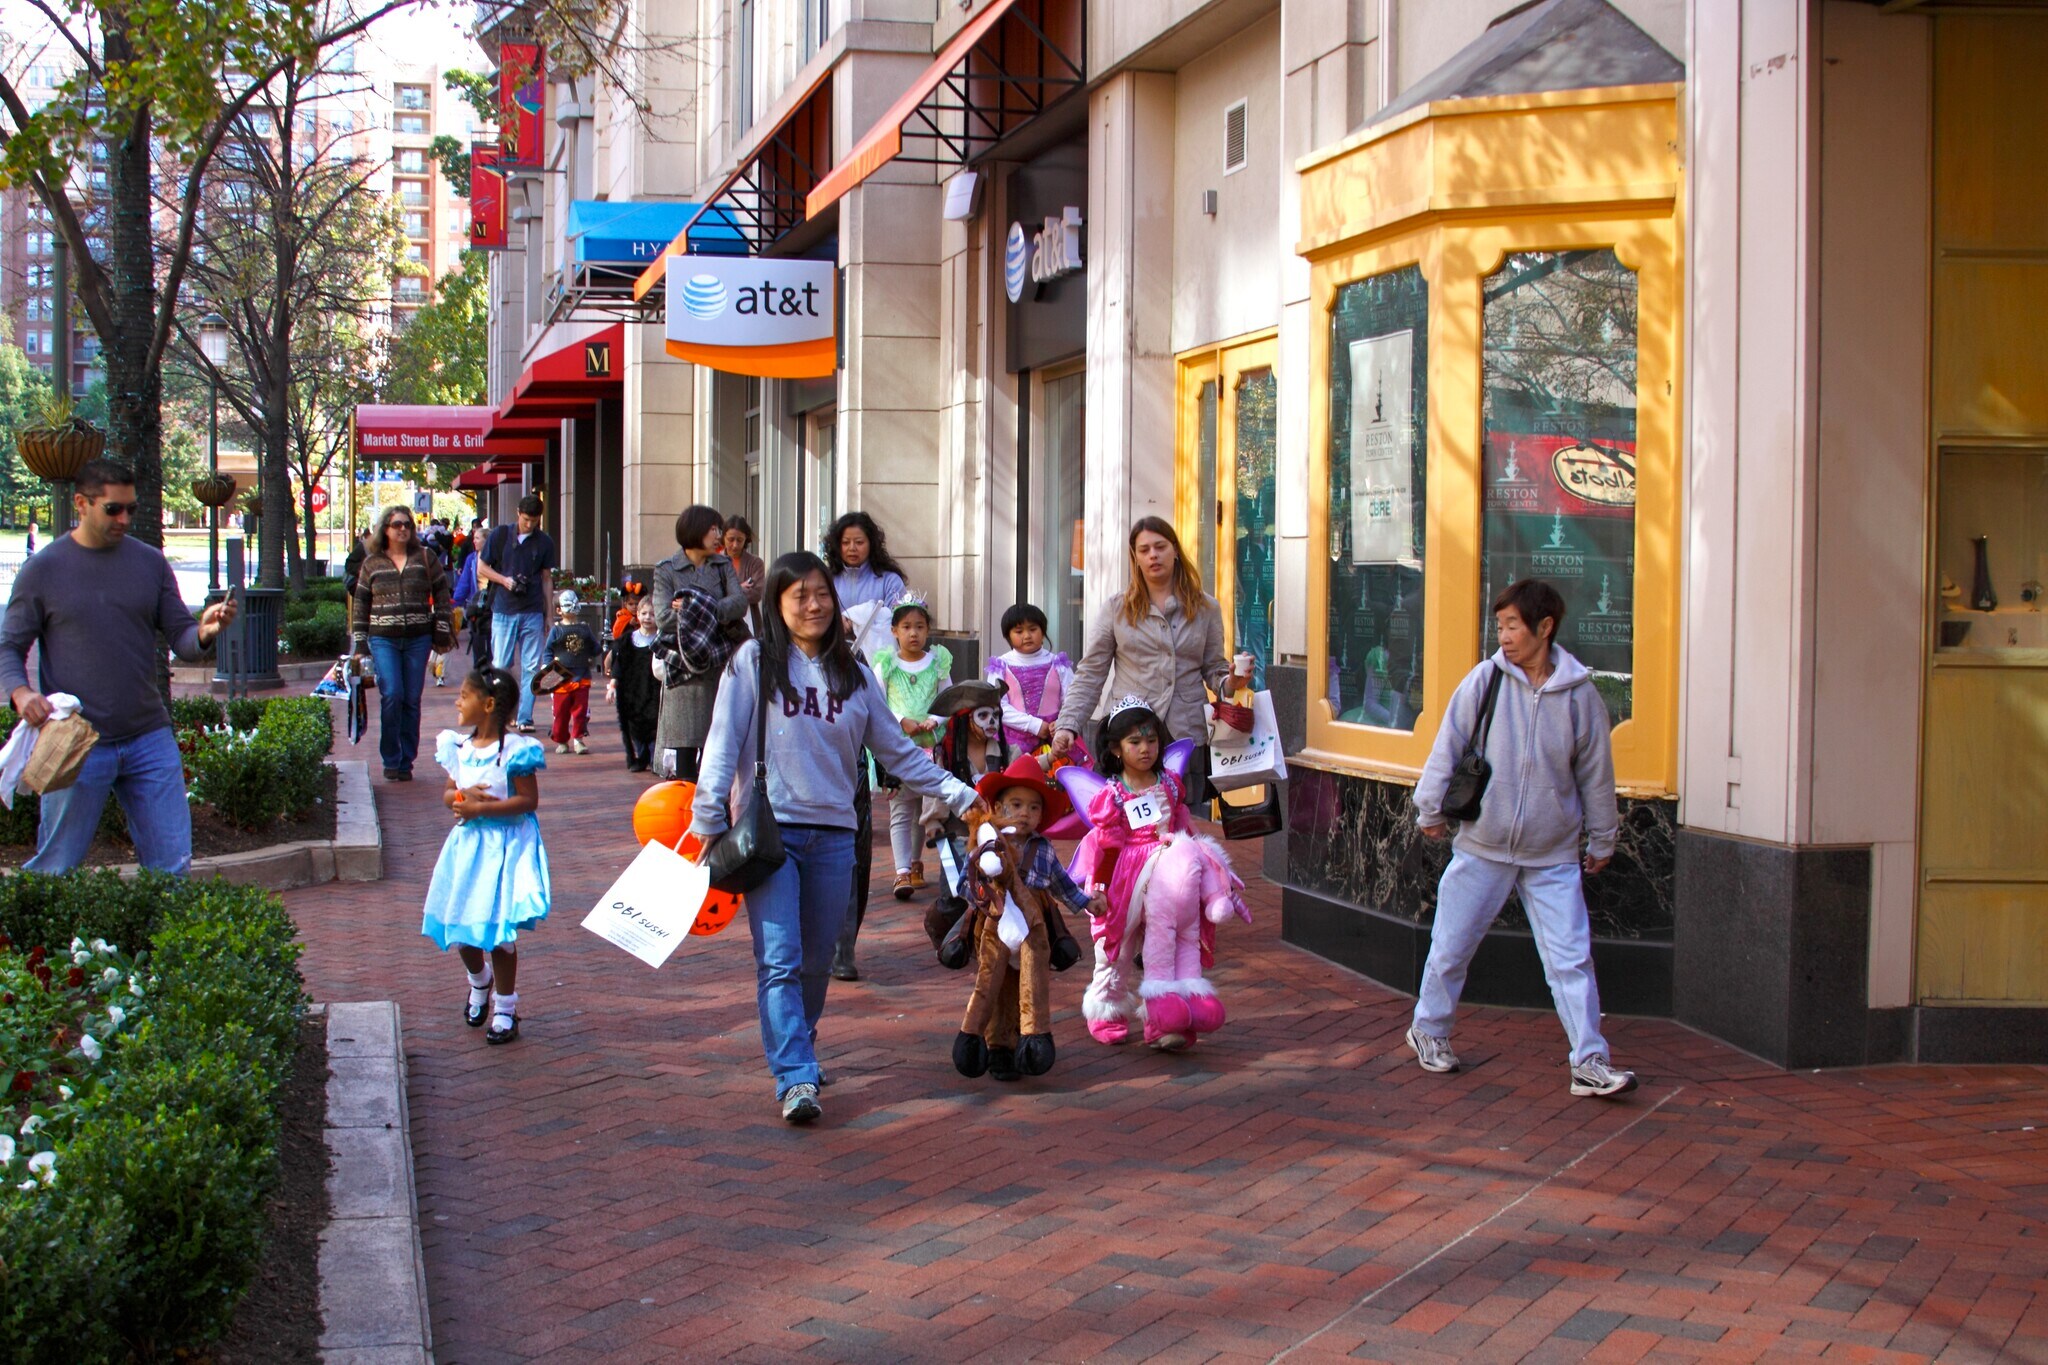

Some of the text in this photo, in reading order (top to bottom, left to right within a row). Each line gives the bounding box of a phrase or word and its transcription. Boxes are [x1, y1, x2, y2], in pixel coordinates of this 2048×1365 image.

[475, 222, 487, 237] M
[632, 242, 700, 257] HYT
[1031, 206, 1083, 284] at&t
[735, 280, 820, 318] at&t
[585, 347, 611, 373] M
[1532, 421, 1587, 432] RESTON
[363, 433, 484, 448] Market Street Bar & Grill
[1365, 430, 1393, 447] RESTON
[300, 492, 327, 506] SOP
[1486, 488, 1539, 499] RESTON
[1531, 554, 1584, 566] RESTON
[1578, 622, 1631, 633] RESTON
[1220, 753, 1243, 766] OBI
[1132, 802, 1152, 819] 15
[612, 901, 670, 938] OBI SUSHI
